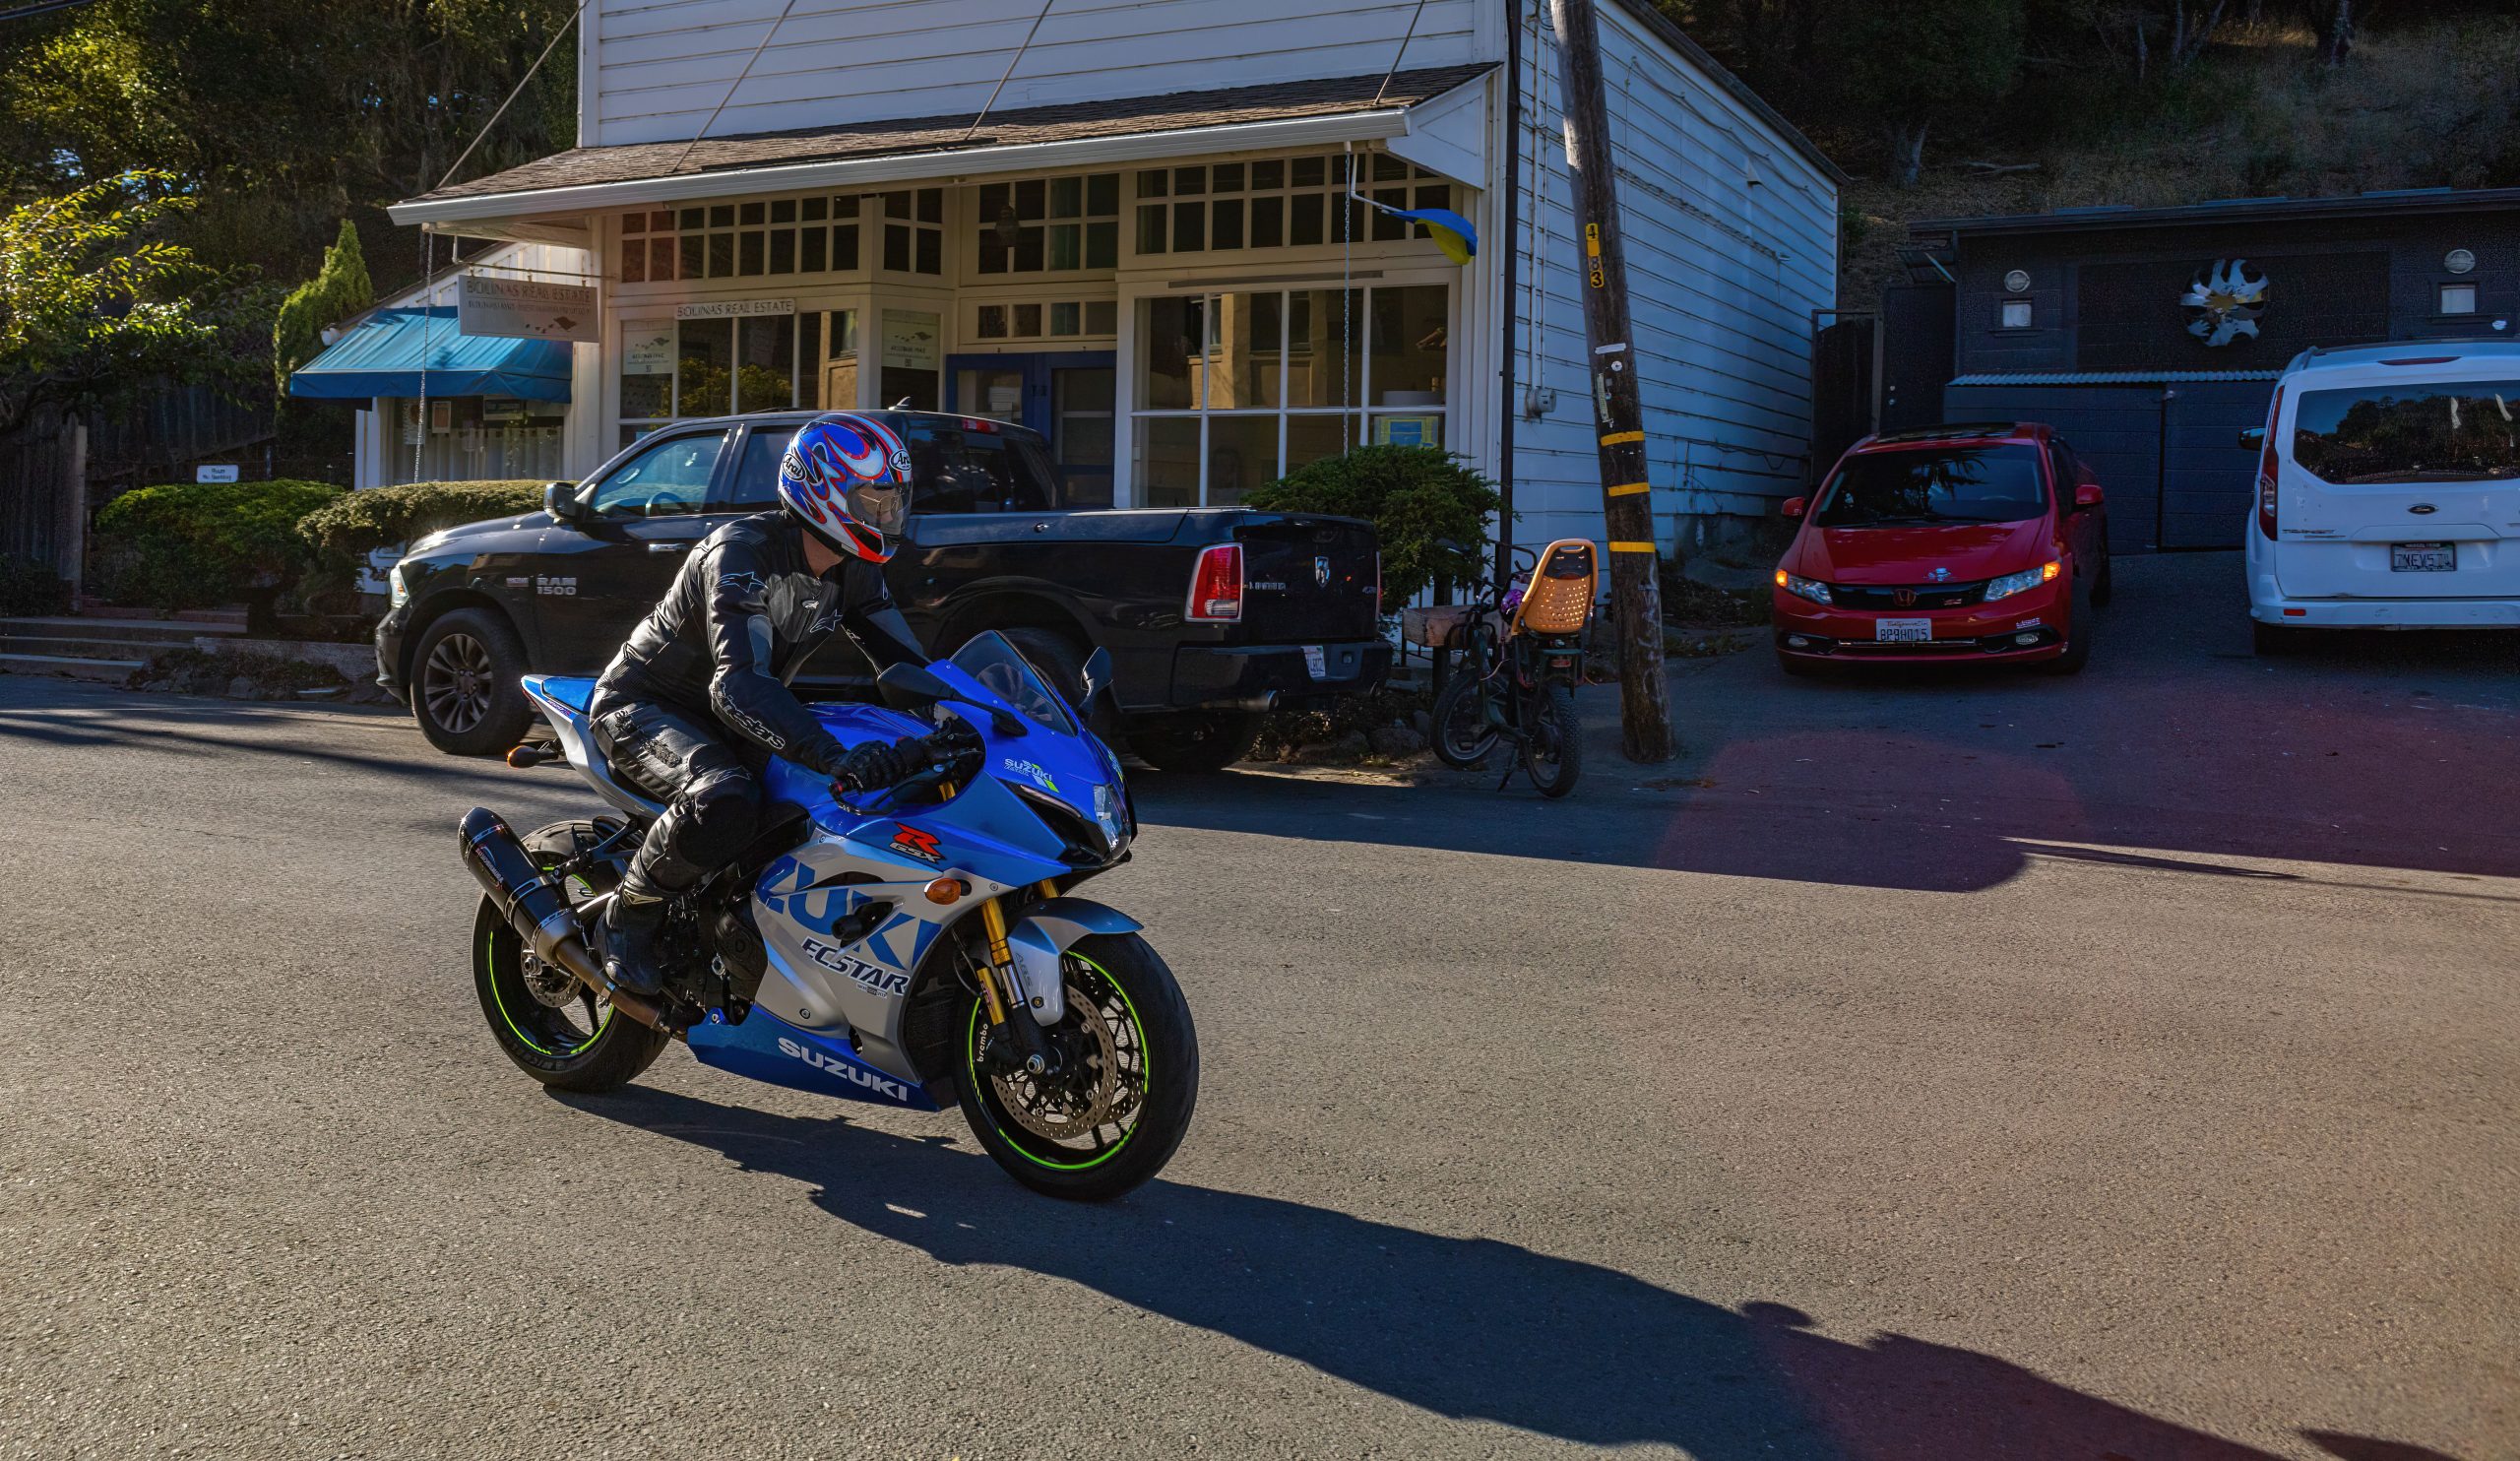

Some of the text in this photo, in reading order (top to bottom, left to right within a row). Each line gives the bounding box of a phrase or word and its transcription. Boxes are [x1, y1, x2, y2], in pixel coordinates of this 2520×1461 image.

[466, 280, 520, 297] BOLINAS
[1592, 271, 1603, 286] 3
[676, 300, 792, 317] BOLINAS REAL ESTATE
[783, 457, 803, 479] Arai
[536, 577, 577, 586] RAM
[536, 586, 577, 596] 1500
[1004, 758, 1053, 781] SUZUKI
[889, 842, 941, 863] GSX
[801, 937, 910, 995] ECSTAR
[976, 1023, 988, 1062] brembo
[778, 1037, 908, 1102] SUZUKI
